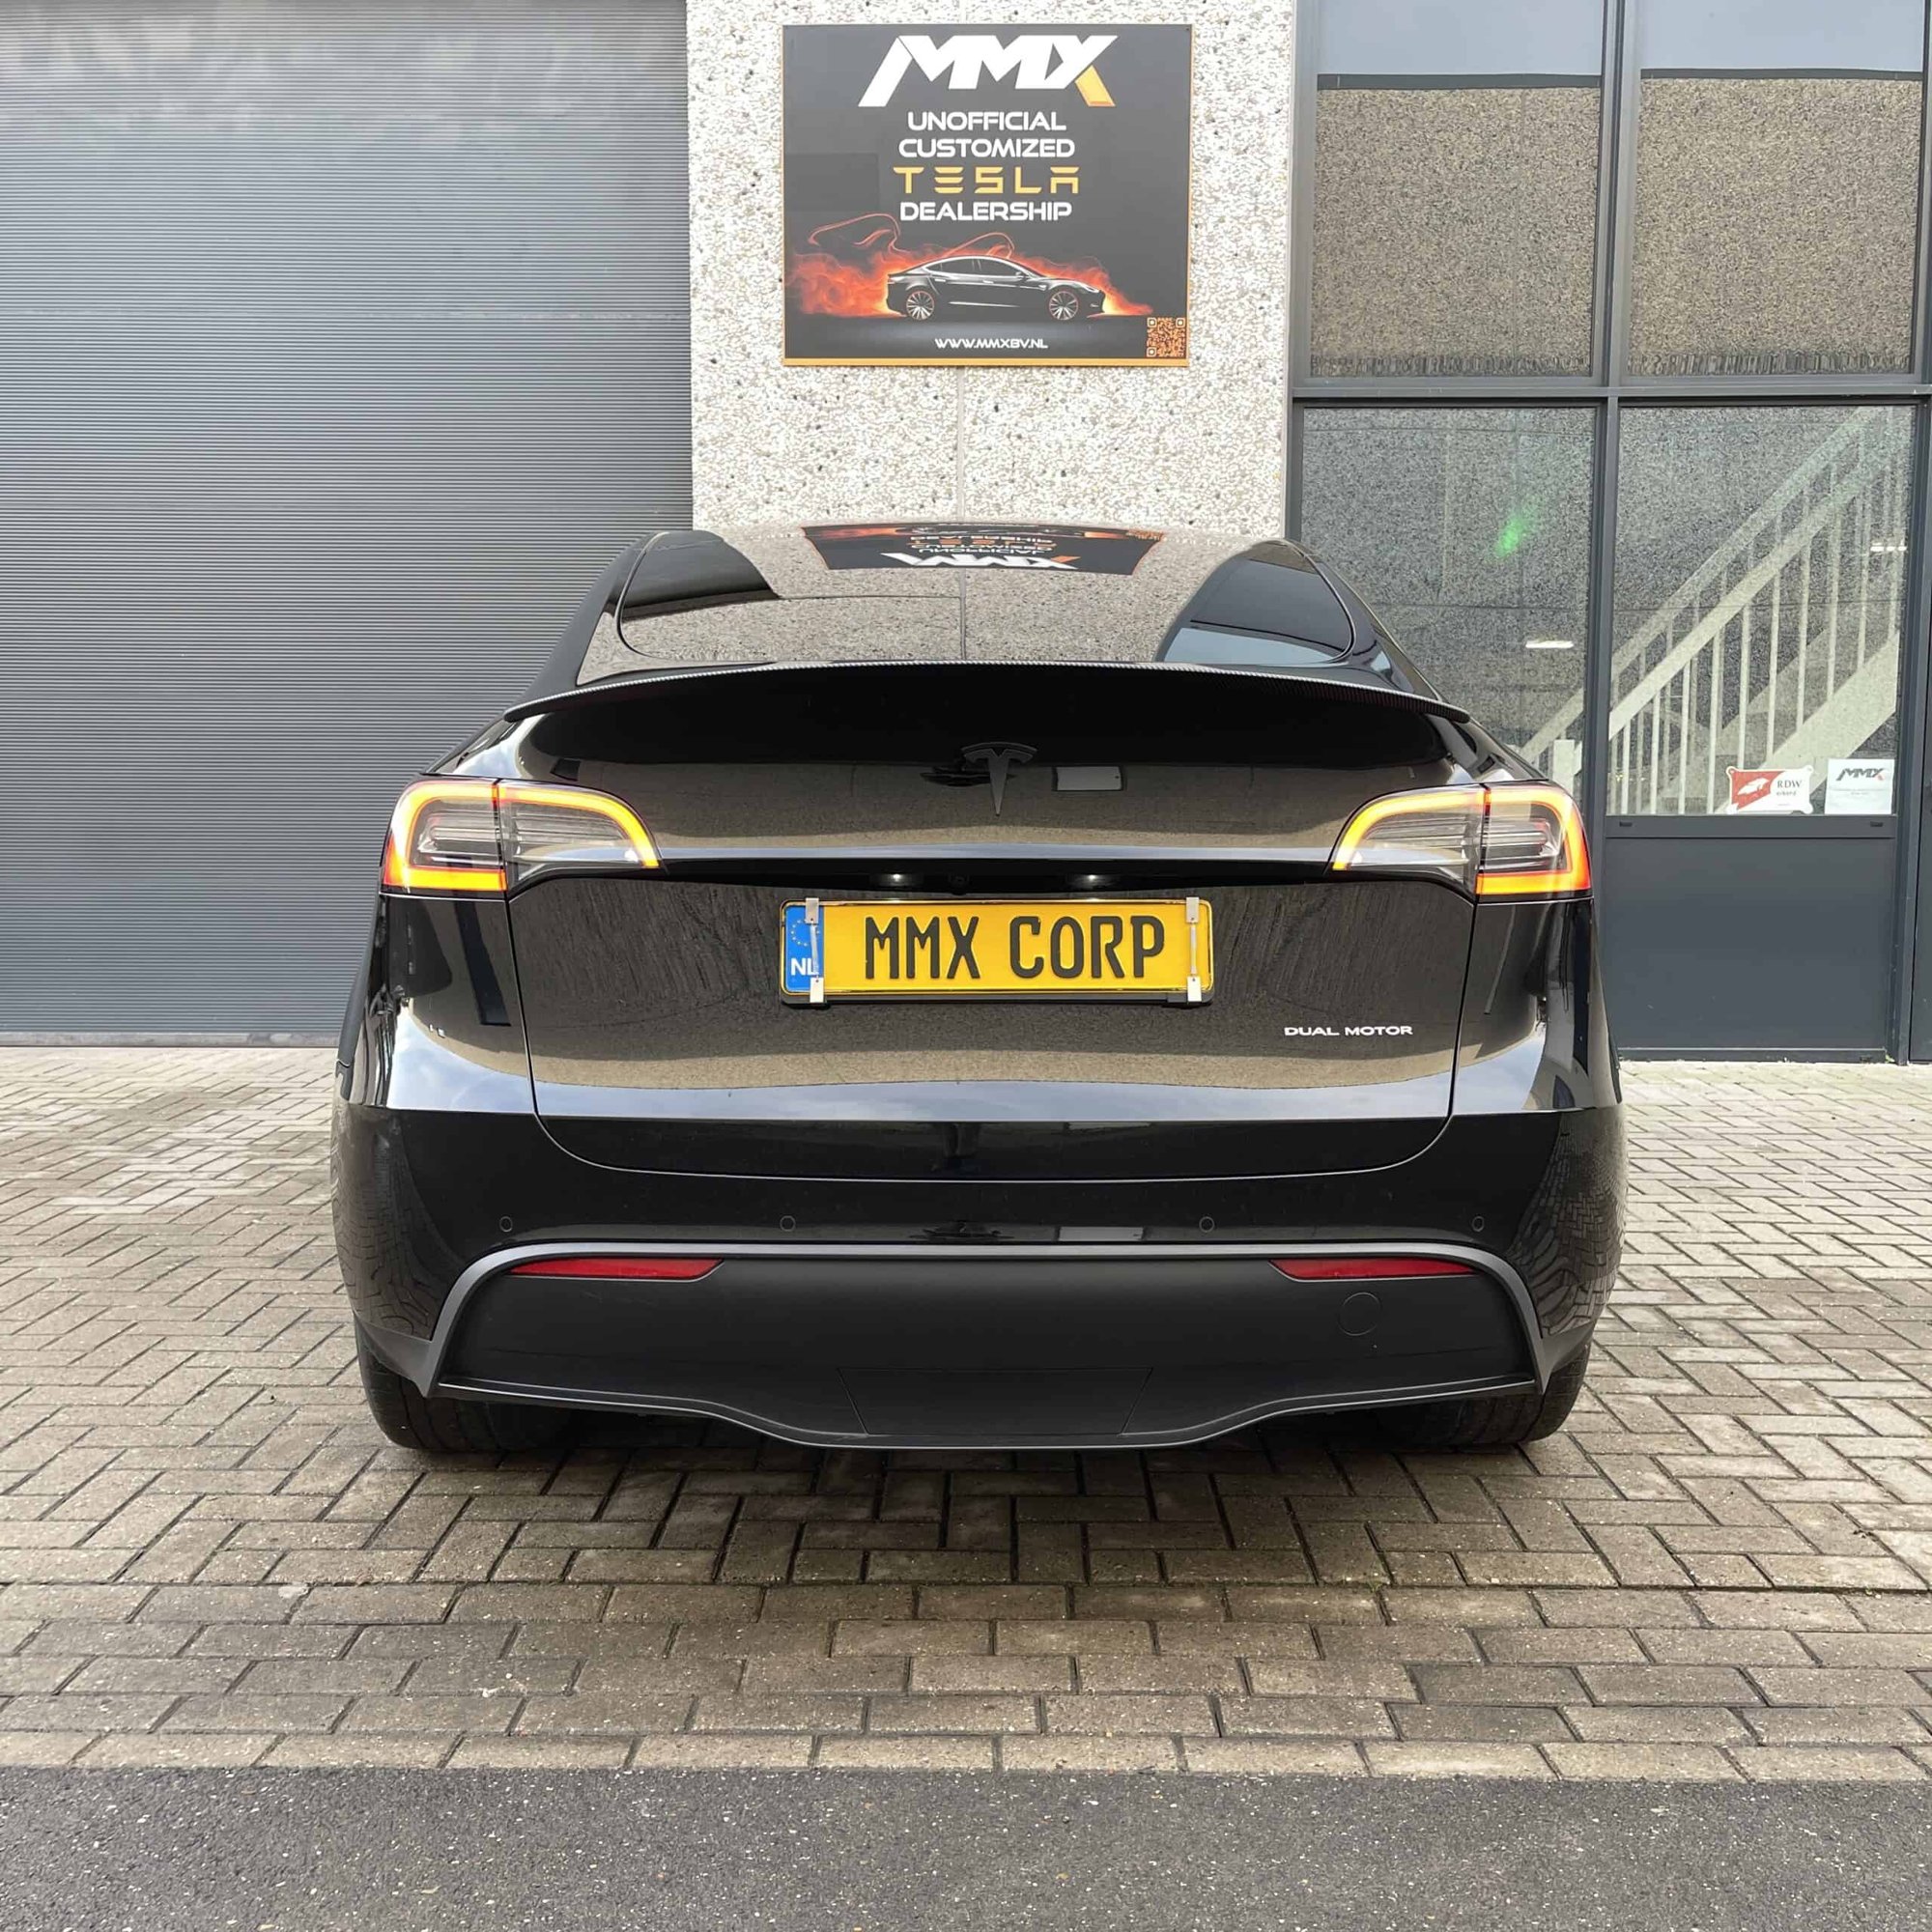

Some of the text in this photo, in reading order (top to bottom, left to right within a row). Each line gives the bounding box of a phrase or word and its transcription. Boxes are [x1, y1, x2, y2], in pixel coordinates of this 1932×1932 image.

[858, 35, 1119, 107] MMX
[907, 111, 1066, 131] UNOFFICIAL
[898, 138, 1075, 157] CUSTOMIZED
[893, 166, 1080, 194] TESLA
[899, 201, 1072, 221] DEALERSHIP
[934, 338, 1048, 349] WWW.MMXBV.NL
[1776, 780, 1802, 788] RDW
[1836, 768, 1885, 781] MMX
[865, 916, 1165, 979] MMX CORP
[790, 957, 819, 976] NL
[1284, 1026, 1413, 1037] DUAL MOTOR
